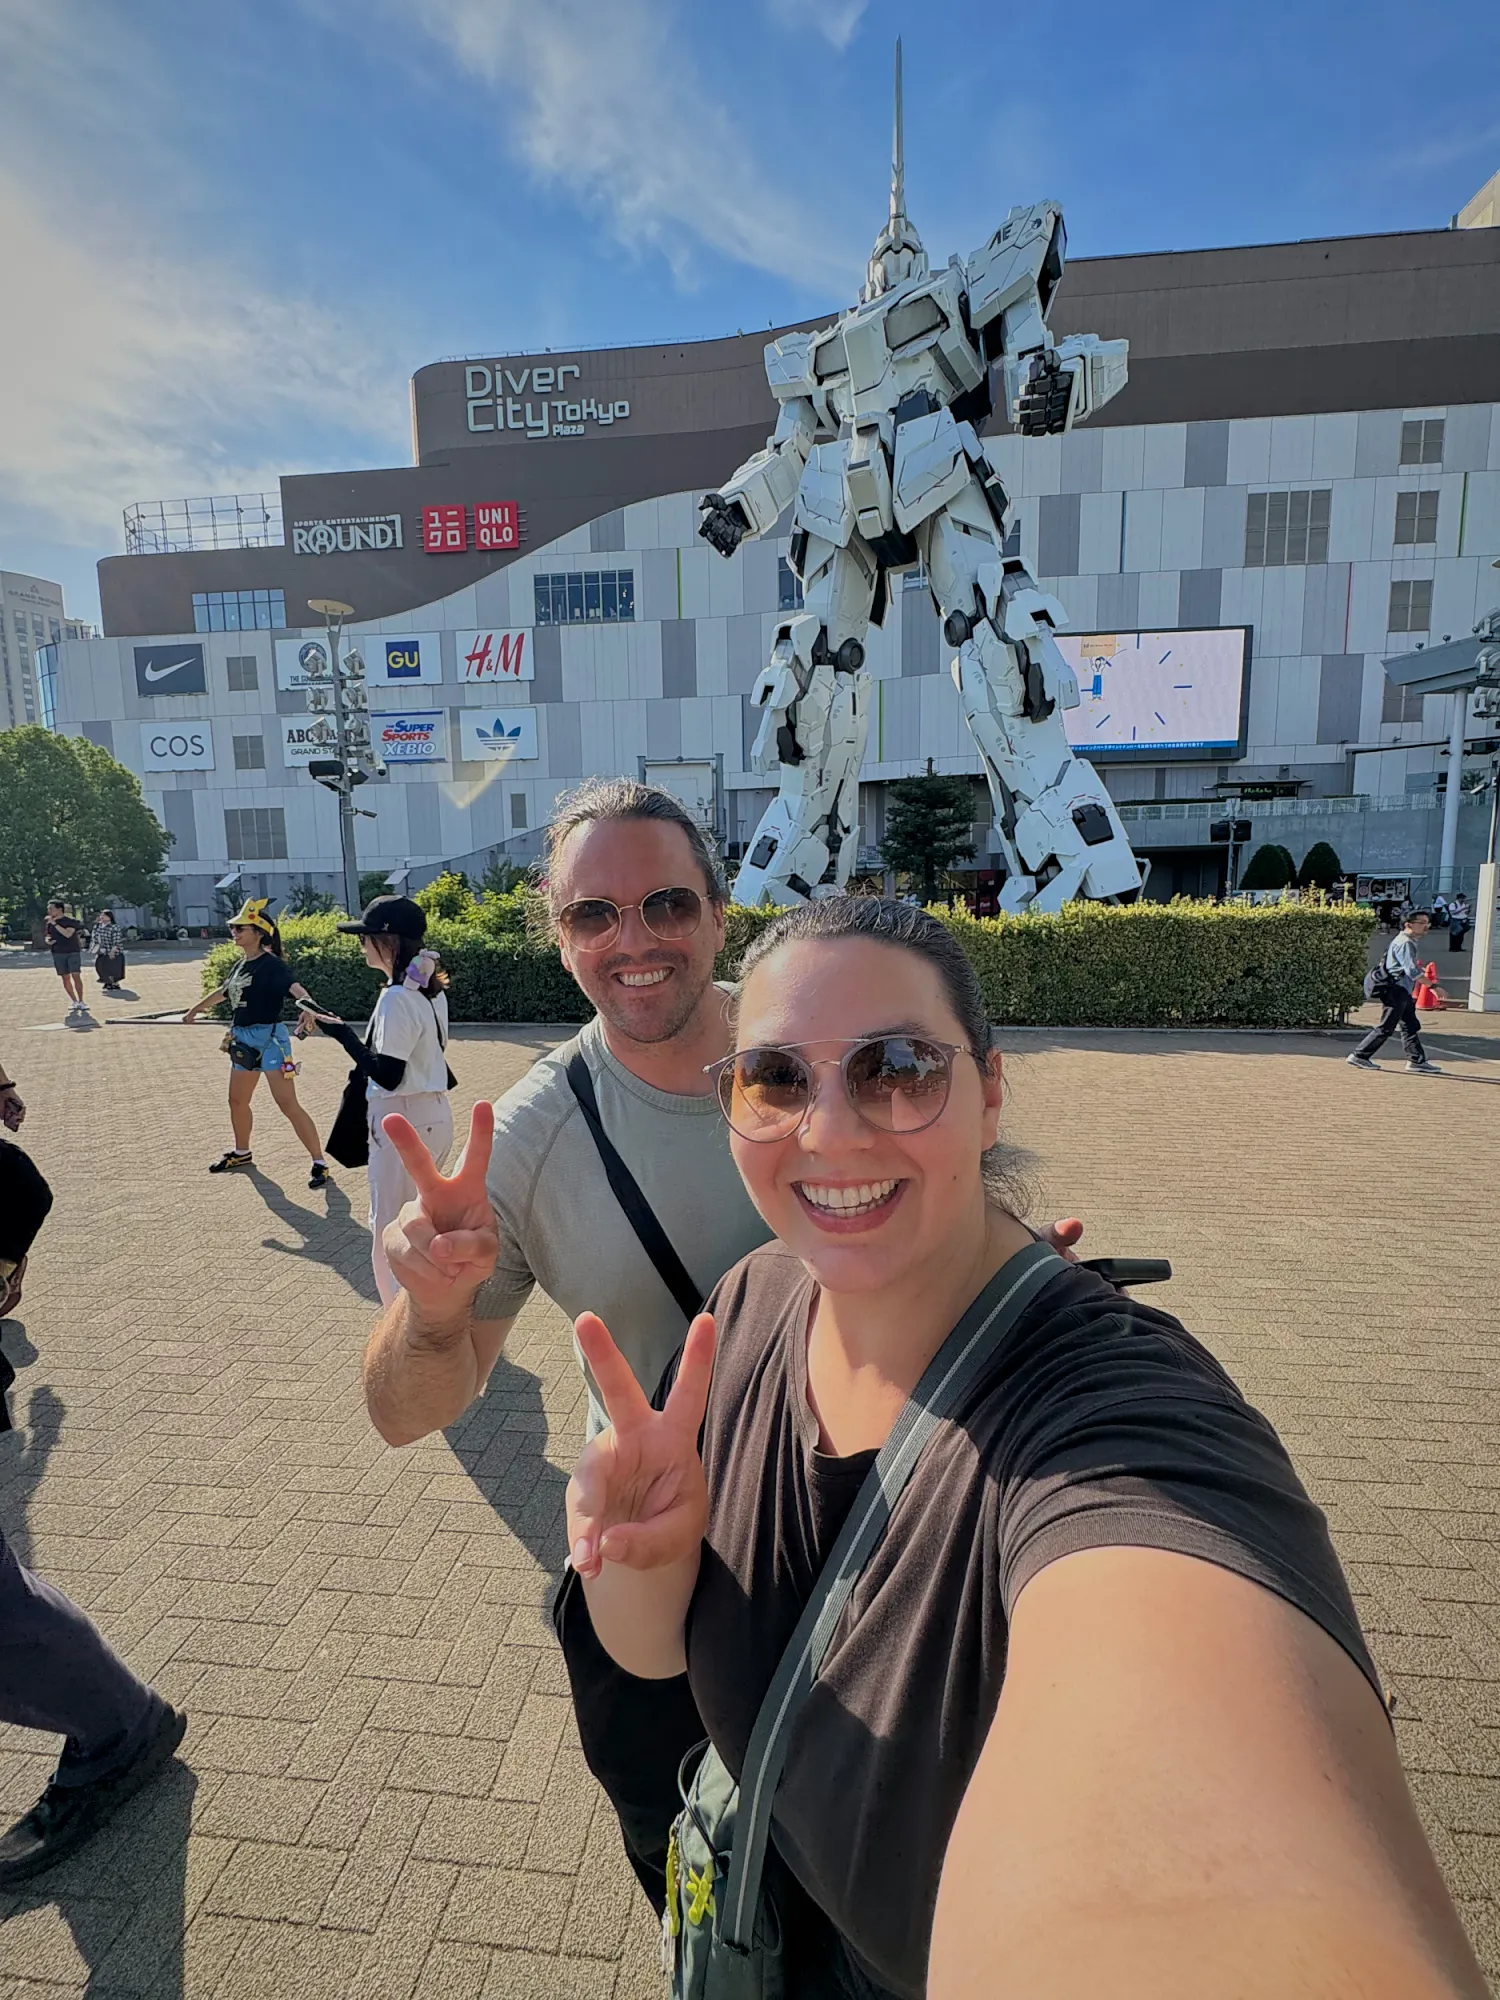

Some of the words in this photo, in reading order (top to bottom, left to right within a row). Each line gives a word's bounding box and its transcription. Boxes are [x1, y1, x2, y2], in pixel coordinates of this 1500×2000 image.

[465, 363, 581, 399] Diver
[467, 397, 550, 439] City
[550, 398, 630, 425] Tokyo
[552, 424, 585, 437] Plaza
[293, 519, 324, 528] SPORTS
[325, 516, 391, 525] ENTERTAINMENT
[428, 510, 460, 528] ユニ
[478, 507, 509, 525] UNI
[428, 529, 461, 547] クロ
[479, 526, 513, 547] QLO
[388, 651, 419, 669] GU
[464, 632, 525, 678] H&M
[381, 729, 430, 741] SPORTS
[393, 720, 435, 732] SUPER
[150, 735, 205, 757] COS
[290, 747, 321, 755] GRAND
[382, 741, 436, 756] XEBIO
